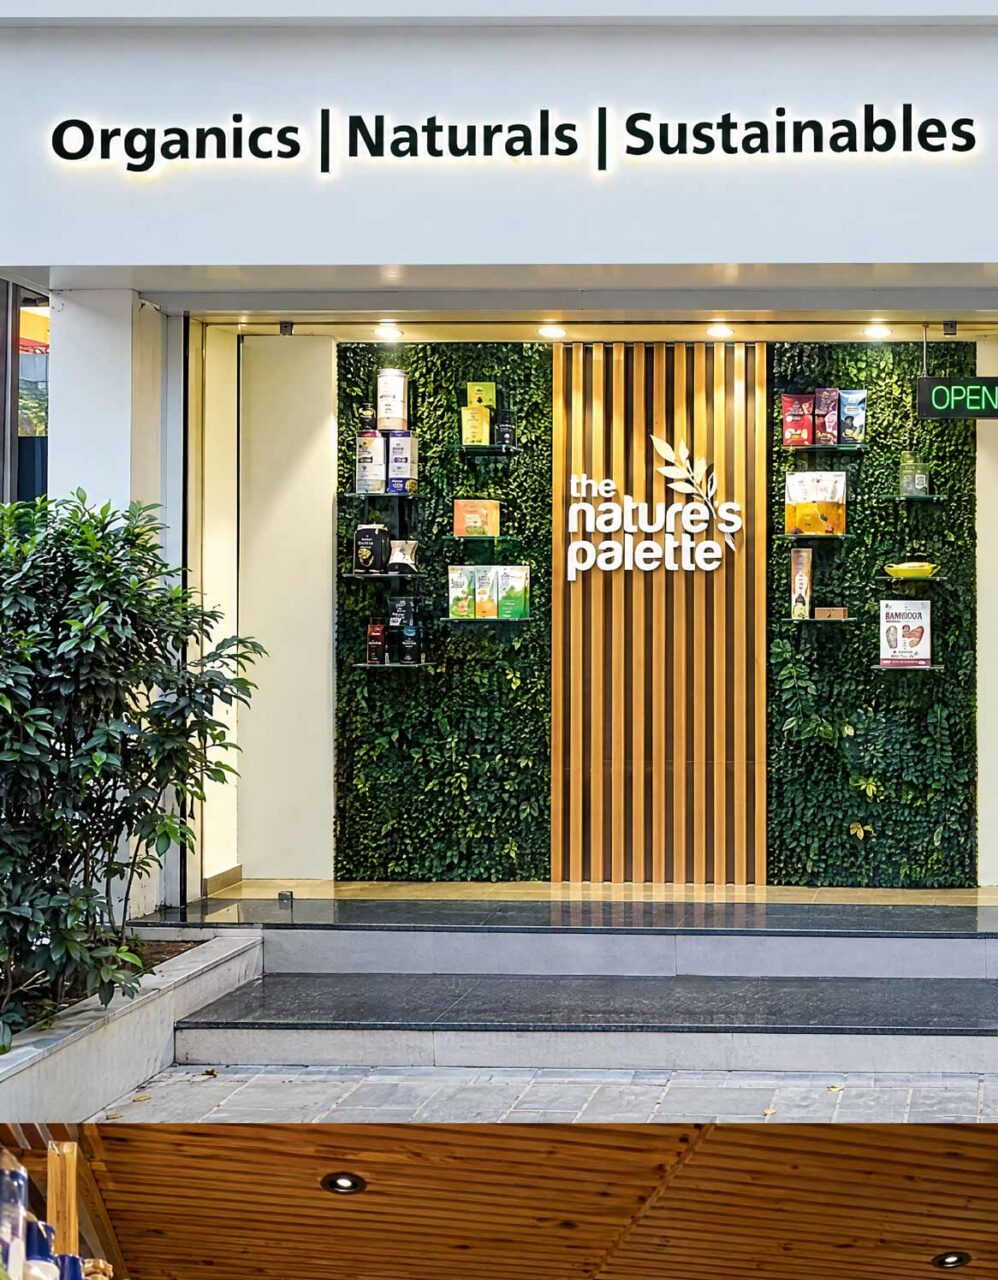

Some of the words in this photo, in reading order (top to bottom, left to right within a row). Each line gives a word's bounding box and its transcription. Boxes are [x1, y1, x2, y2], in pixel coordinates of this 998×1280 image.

[51, 114, 301, 172] Organics
[348, 110, 578, 158] Naturals
[625, 104, 976, 156] Sustainables
[931, 385, 998, 410] OPEN
[570, 473, 617, 498] the
[567, 533, 723, 581] palette
